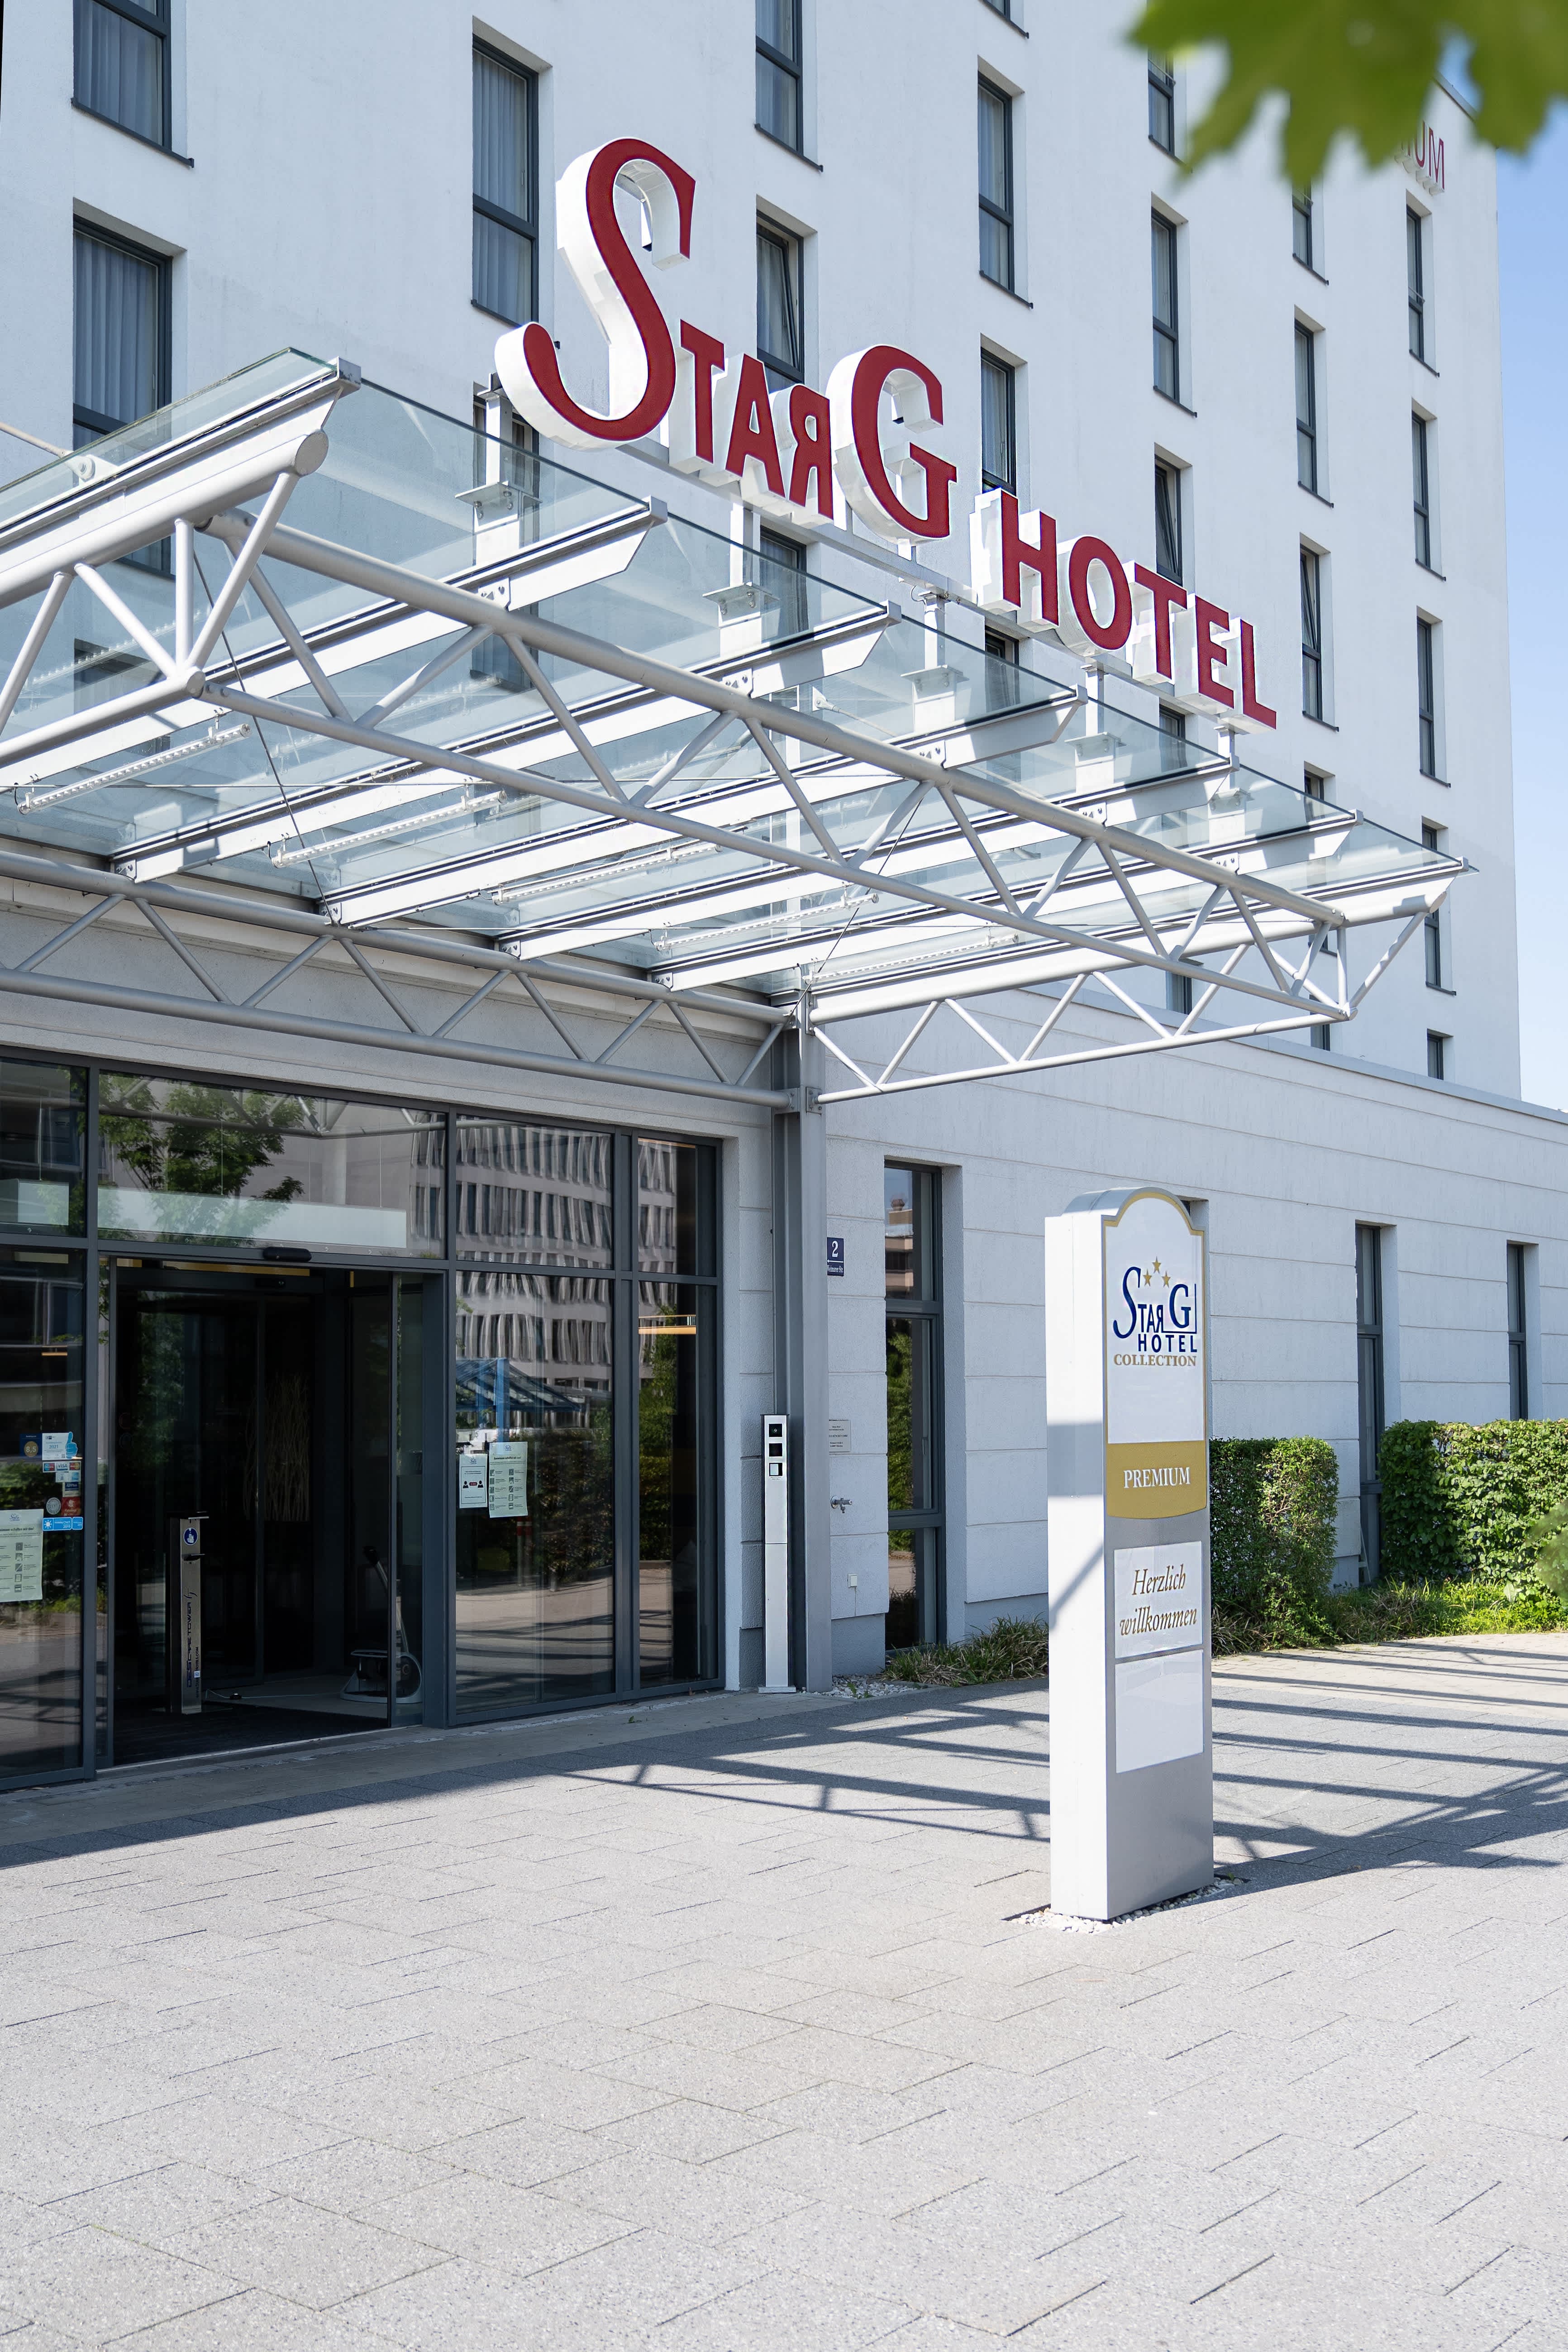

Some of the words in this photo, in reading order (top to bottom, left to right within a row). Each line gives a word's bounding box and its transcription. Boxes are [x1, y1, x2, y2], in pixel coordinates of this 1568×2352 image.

[1001, 491, 1277, 729] HOTEL
[832, 1240, 839, 1257] 2
[1138, 1333, 1197, 1353] HOTEL
[1113, 1353, 1197, 1367] COLLECTION
[1123, 1466, 1191, 1489] PREMIUM
[1131, 1564, 1186, 1596] Herzlich
[1119, 1605, 1197, 1636] willkommen
